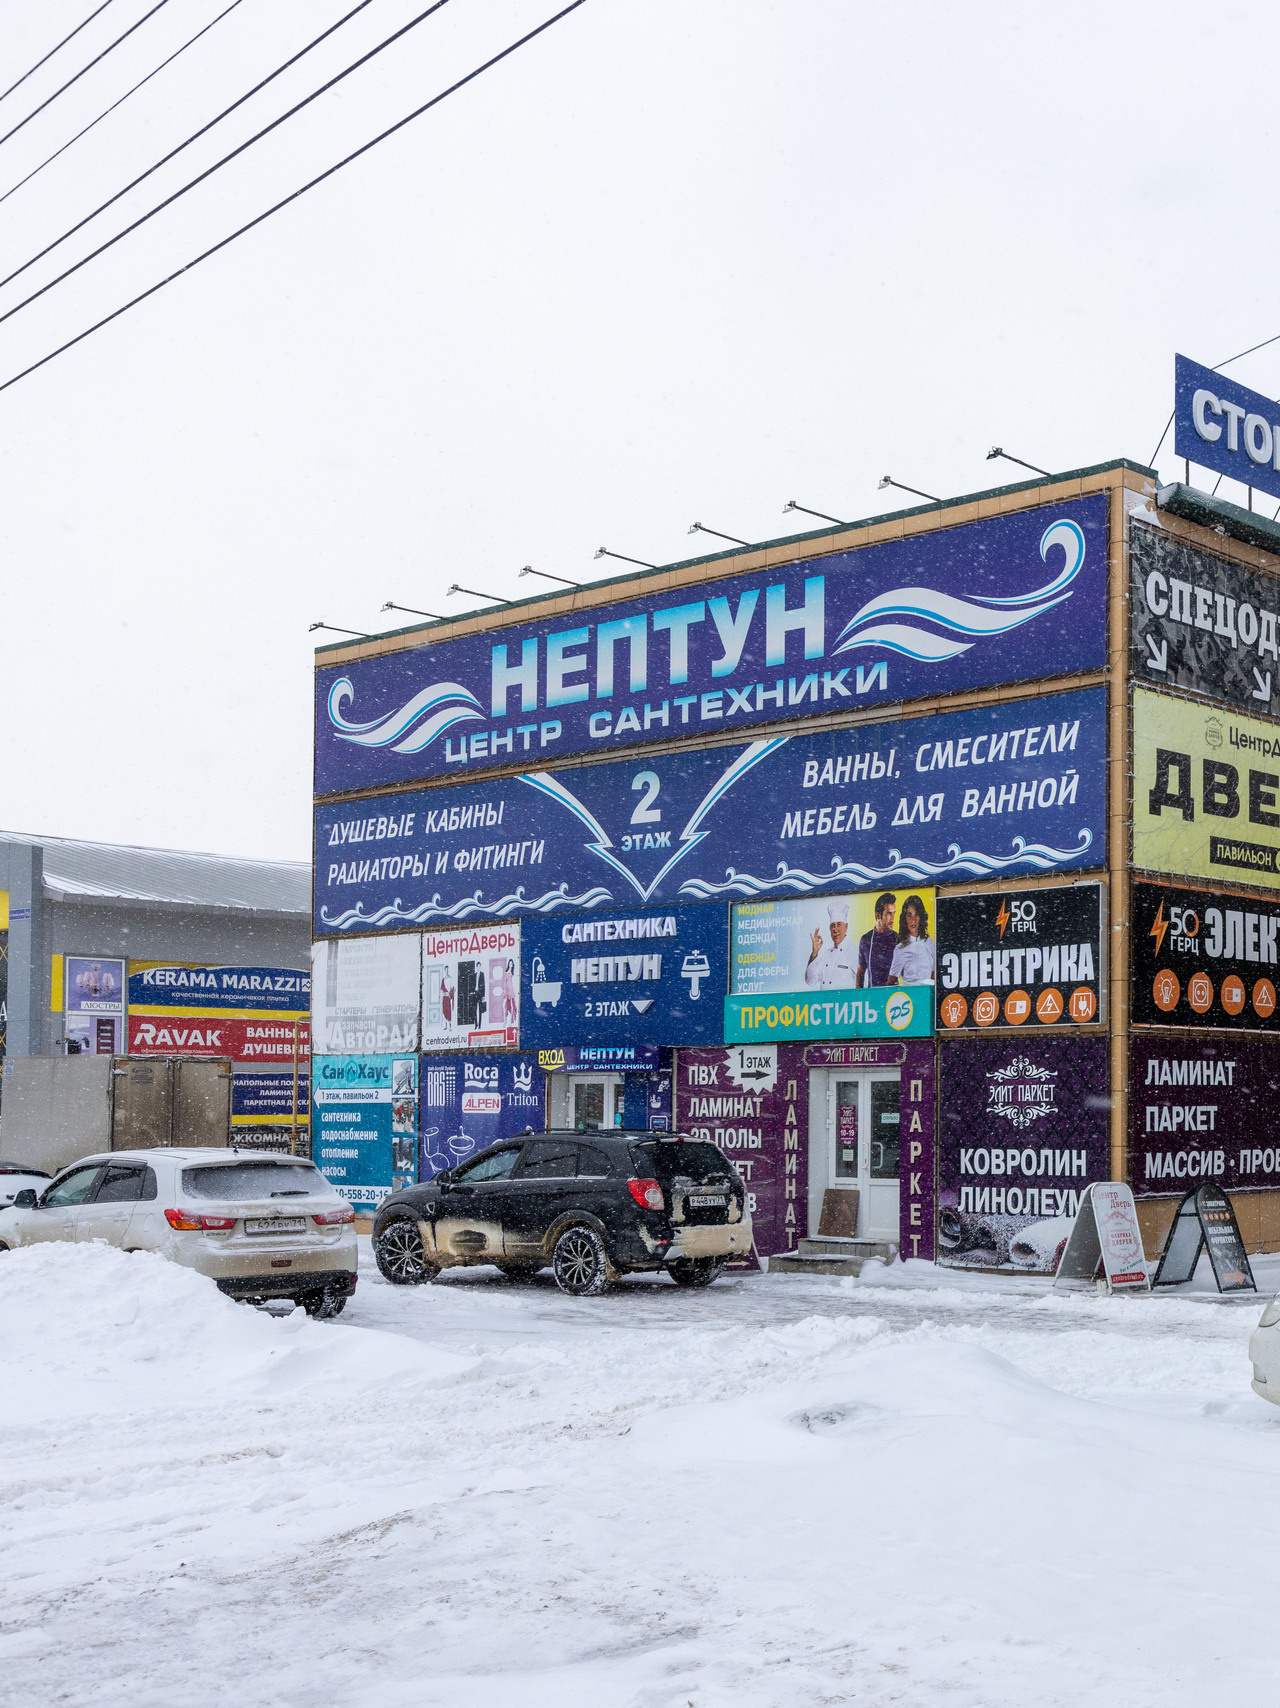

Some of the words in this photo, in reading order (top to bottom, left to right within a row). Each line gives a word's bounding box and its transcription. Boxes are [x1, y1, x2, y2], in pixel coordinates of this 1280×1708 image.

[491, 575, 825, 718] НЕПТУН
[446, 720, 562, 764] ЦЕНТР
[589, 661, 888, 738] САНТЕХНИКИ
[802, 749, 900, 789] ВАННЫ,
[915, 720, 1080, 773] СМЕСИТЕЛИ
[630, 770, 661, 824] 2
[780, 803, 877, 839] МЕБЕЛЬ
[892, 792, 944, 826] ДЛЯ
[961, 768, 1080, 818] ВАННОЙ
[328, 812, 415, 846] ДУШЕВЫЕ
[425, 801, 505, 834] КАБИНЫ
[621, 830, 672, 851] ЭТАЖ
[327, 852, 430, 886] РАДИАТОРЫ
[434, 850, 449, 874] И
[454, 840, 545, 872] ФИТИНГИ
[1217, 844, 1272, 866] ПАВИЛЬОН
[738, 903, 774, 916] МОДНАЯ
[1011, 901, 1036, 921] 50
[561, 916, 677, 943] САНТЕХНИКА
[738, 915, 804, 931] МЕДИЦИНСКАЯ
[1011, 921, 1037, 933] ГЕРЦ
[1170, 907, 1199, 937] 50
[426, 932, 516, 957] ЦентрДверь
[738, 932, 776, 945] ОДЕЖДА
[1170, 935, 1199, 956] ГЕРЦ
[738, 952, 776, 965] ОДЕЖДА
[942, 943, 1095, 989] ЭЛЕКТРИКА
[570, 954, 662, 984] НЕПТУН
[737, 968, 756, 979] ДЛЯ
[758, 966, 789, 977] СФЕРЫ
[143, 971, 218, 989] KERAMA
[222, 974, 300, 992] MARAZZI
[737, 981, 765, 992] УСЛУГ
[84, 1002, 120, 1010] ЛЮСТРЫ
[335, 1007, 367, 1015] СТАРТЕРЫ
[372, 1004, 418, 1013] ГЕНЕРАТОРЫ
[585, 1002, 593, 1018] 2
[595, 1000, 630, 1017] ЭТАЖ
[740, 1001, 878, 1029] ПРОФИСТИЛЬ
[134, 1024, 221, 1047] RAVAK
[342, 1021, 376, 1030] запчасти
[426, 1035, 467, 1045] centrodveri.ru
[538, 1049, 565, 1066] ВХОД
[580, 1048, 635, 1060] НЕПТУН
[738, 1050, 744, 1069] 1
[746, 1054, 771, 1068] ЭТАЖ
[826, 1048, 845, 1063] ЭЛИТ
[849, 1046, 879, 1062] ПАРКЕТ
[322, 1064, 344, 1080] Сан
[358, 1063, 389, 1083] Хаус
[464, 1062, 499, 1079] Roca
[688, 1065, 719, 1086] ПВХ
[1145, 1059, 1236, 1086] ЛАМИНАТ
[326, 1092, 342, 1101] этаж,
[343, 1091, 374, 1100] павильон
[375, 1091, 379, 1099] 2
[464, 1096, 500, 1109] ALPEN
[507, 1092, 538, 1106] Triton
[989, 1085, 1013, 1103] ЭЛИТ
[1018, 1084, 1055, 1102] ПАРКЕТ
[321, 1112, 361, 1123] сантехника
[688, 1098, 763, 1119] ЛАМИНАТ
[1145, 1105, 1218, 1132] ПАРКЕТ
[321, 1130, 378, 1142] водоснабжение
[714, 1127, 762, 1149] ПОЛЫ
[321, 1149, 358, 1159] отопление
[783, 1079, 799, 1249] ЛАМИНАТ
[960, 1148, 1087, 1177] КОВРОЛИН
[1145, 1150, 1225, 1178] МАССИВ
[322, 1167, 346, 1177] насосы
[909, 1079, 922, 1258] ПАРКЕТ
[958, 1186, 1085, 1216] ЛИНОЛЕУМ
[1110, 1199, 1132, 1209] Дверь
